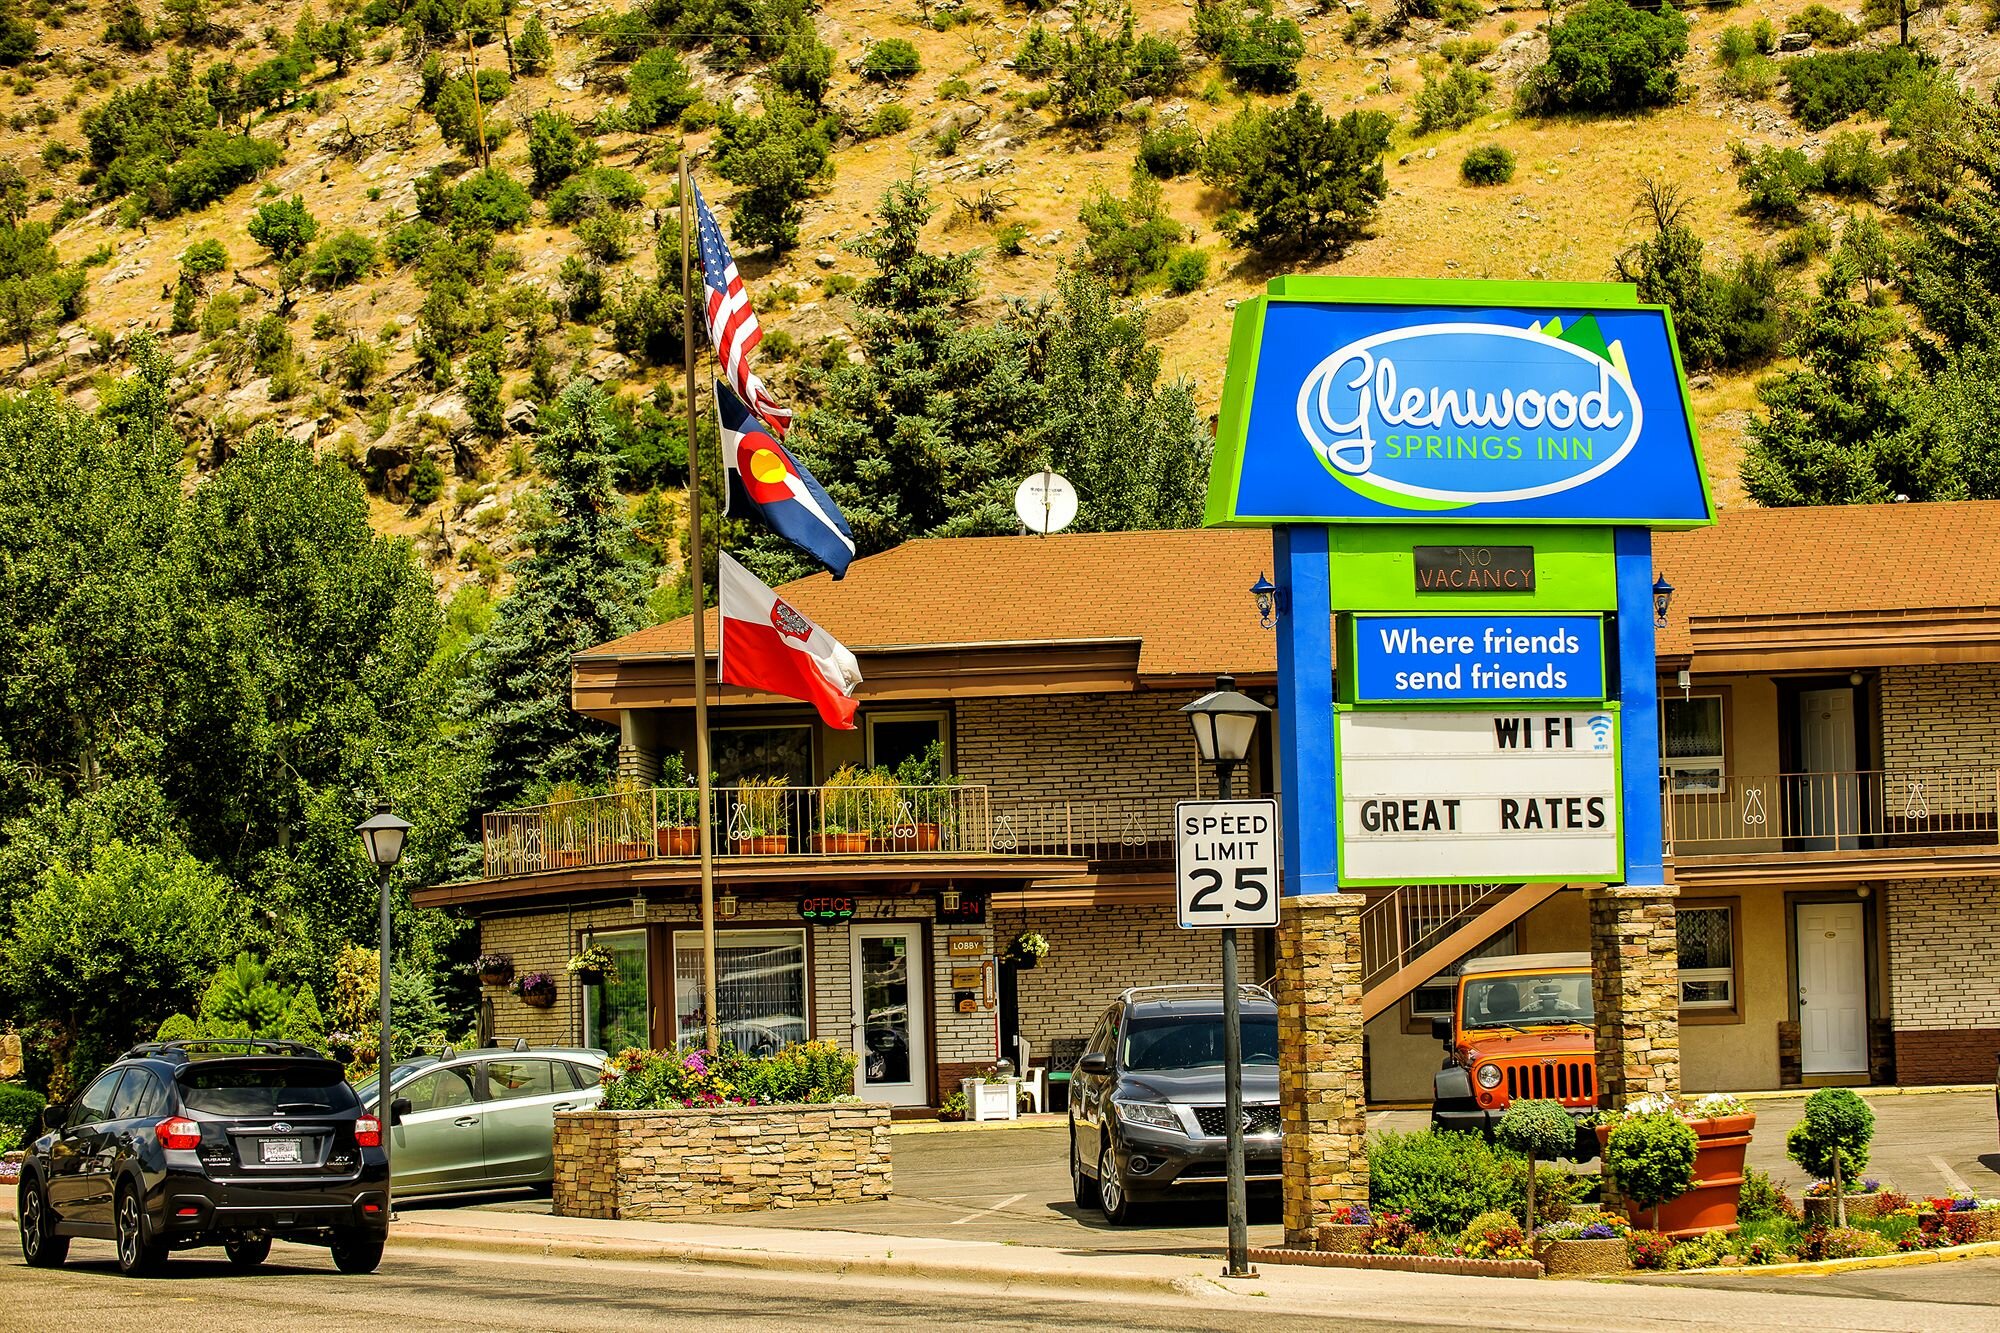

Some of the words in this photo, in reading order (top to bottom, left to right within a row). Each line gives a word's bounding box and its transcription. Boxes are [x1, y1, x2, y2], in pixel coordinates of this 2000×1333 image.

[1319, 348, 1623, 474] Glenwood
[1385, 435, 1524, 460] SPRINGS
[1537, 437, 1594, 461] INN
[1458, 548, 1491, 567] NO
[1419, 569, 1534, 588] VACANCY
[1380, 628, 1475, 654] Where
[1483, 626, 1580, 654] friends
[1394, 664, 1462, 690] send
[1471, 663, 1568, 690] friends
[1185, 816, 1268, 836] SPEED
[1360, 800, 1460, 832] GREAT
[1501, 797, 1605, 829] RATES
[1195, 842, 1259, 861] LIMIT
[1188, 867, 1268, 912] 25
[803, 898, 852, 911] OFFICE
[953, 942, 979, 950] LOBBY
